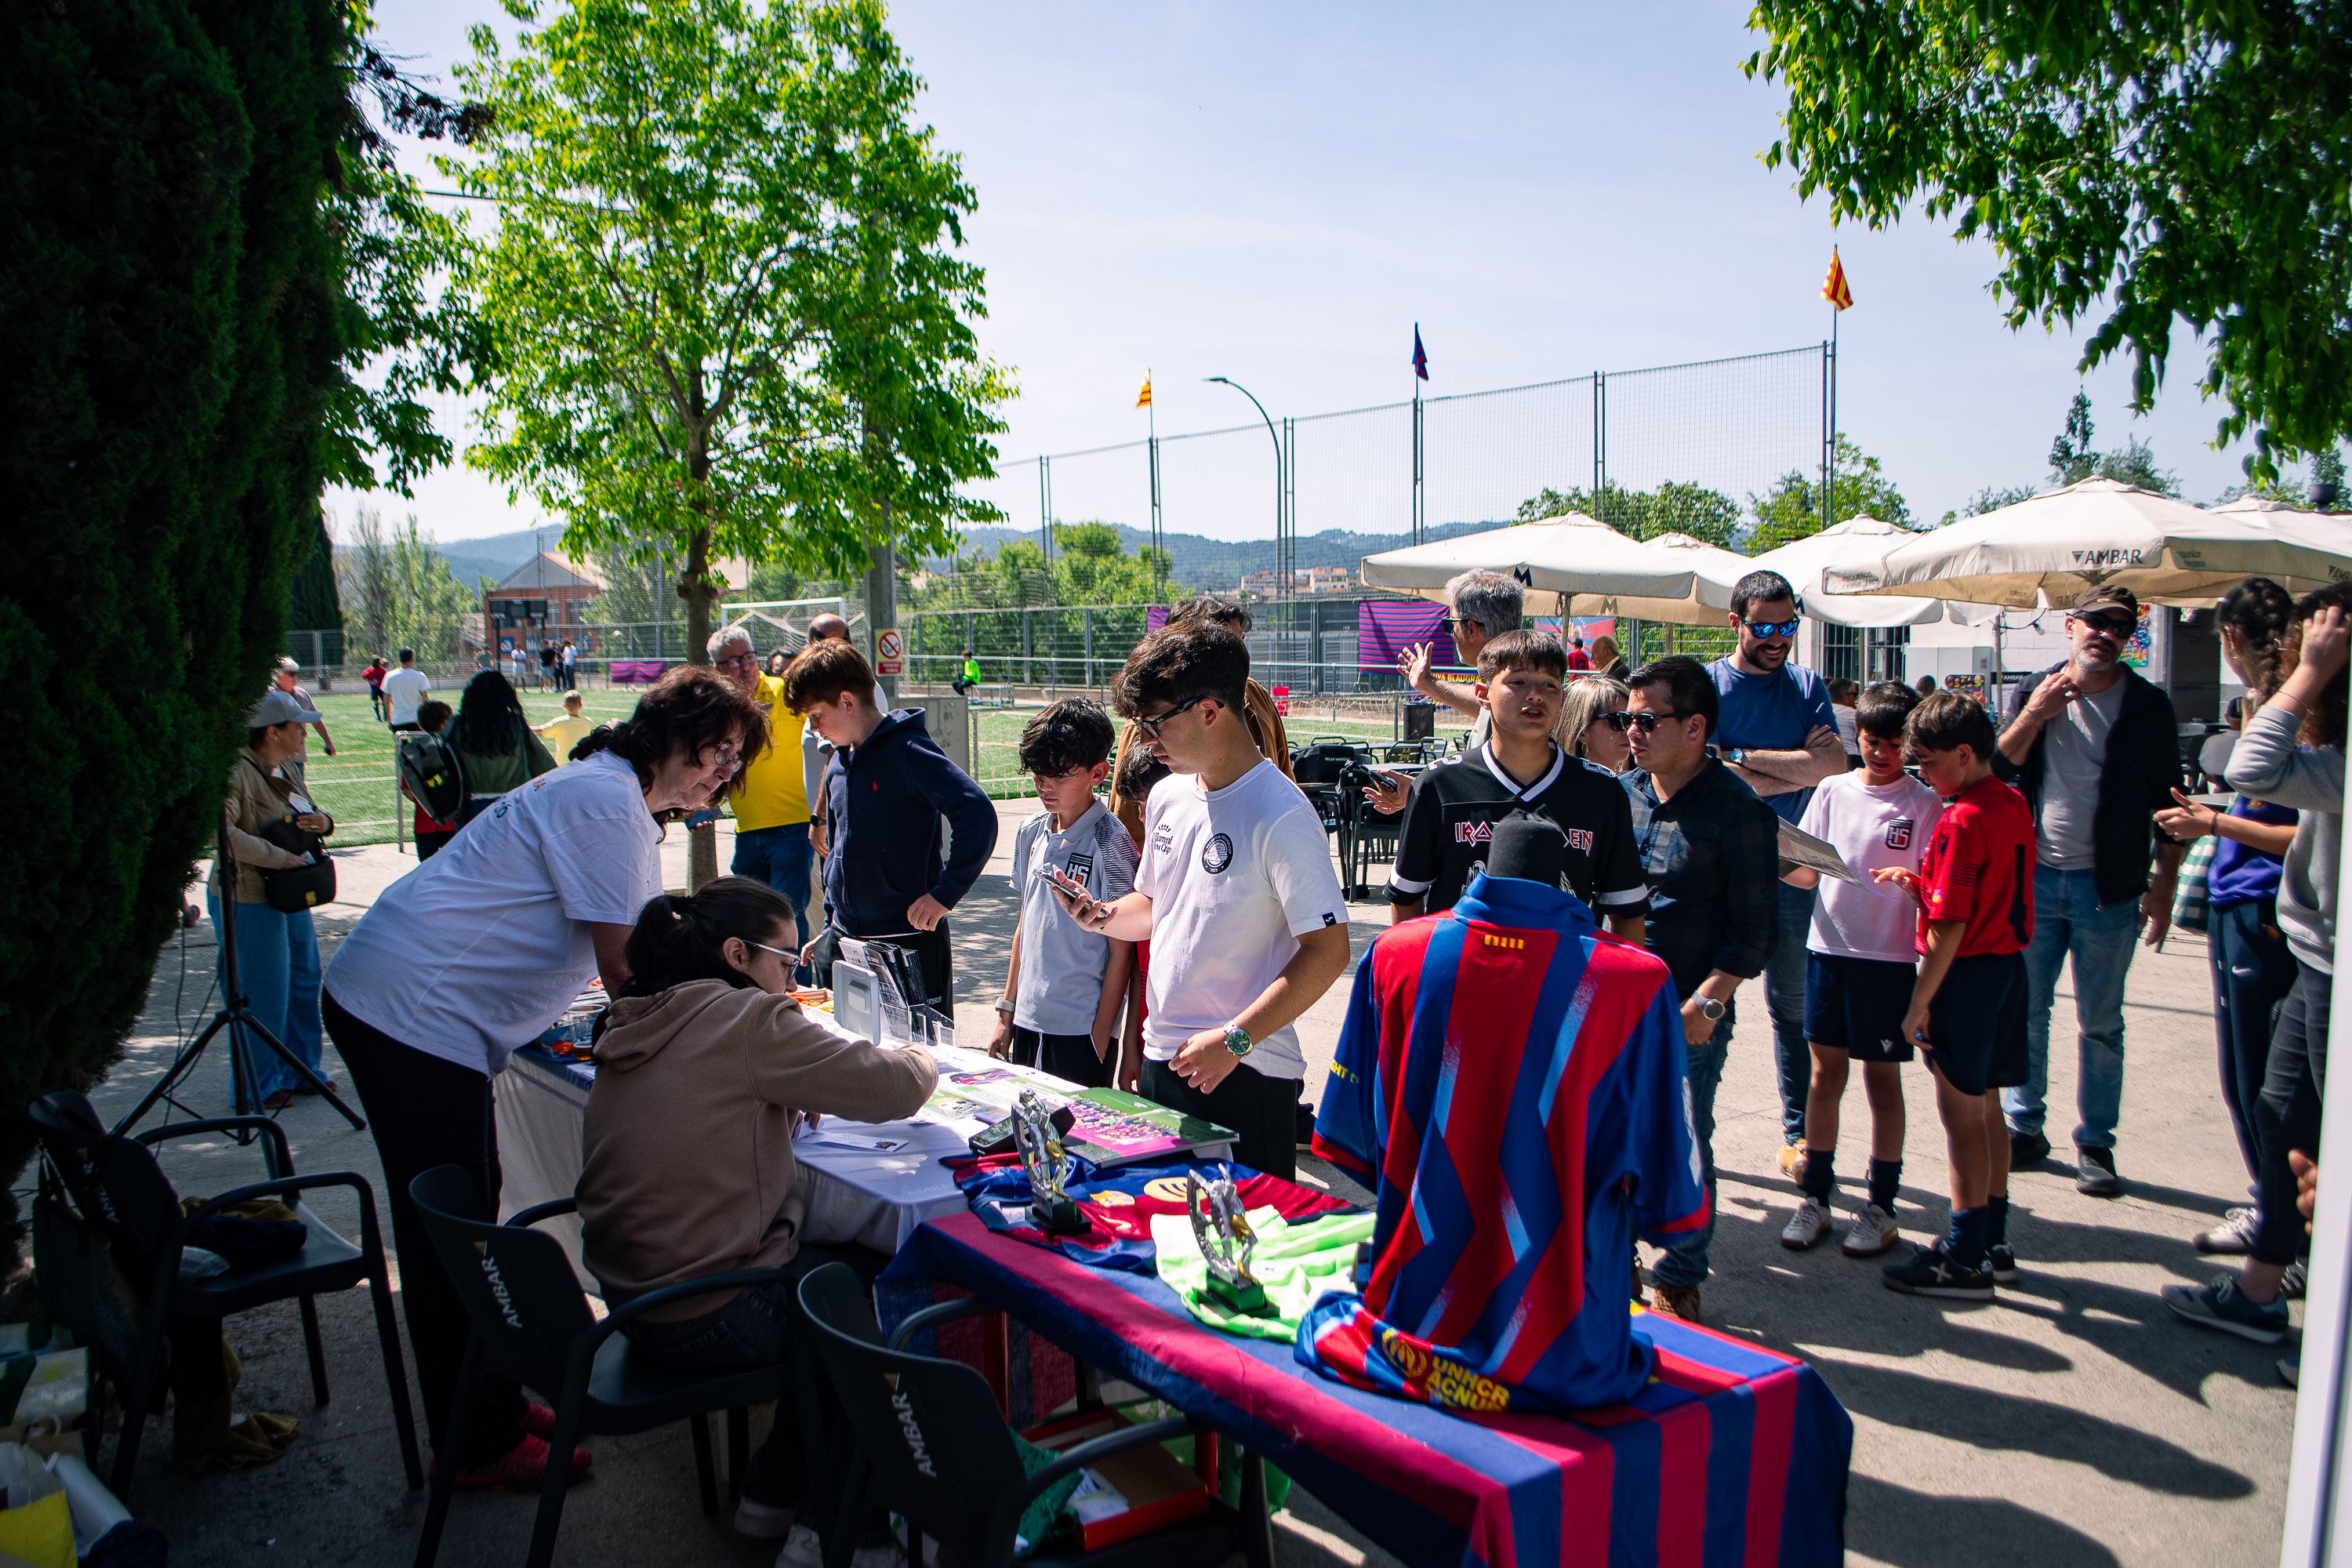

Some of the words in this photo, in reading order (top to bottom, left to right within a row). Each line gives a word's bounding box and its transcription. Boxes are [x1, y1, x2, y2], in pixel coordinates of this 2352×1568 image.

[2084, 549, 2144, 564] AMBAR
[1455, 822, 1499, 848] IRO
[481, 1255, 523, 1329] AMBAR
[1432, 1356, 1510, 1408] UNHCR
[891, 1392, 937, 1477] AMBAR
